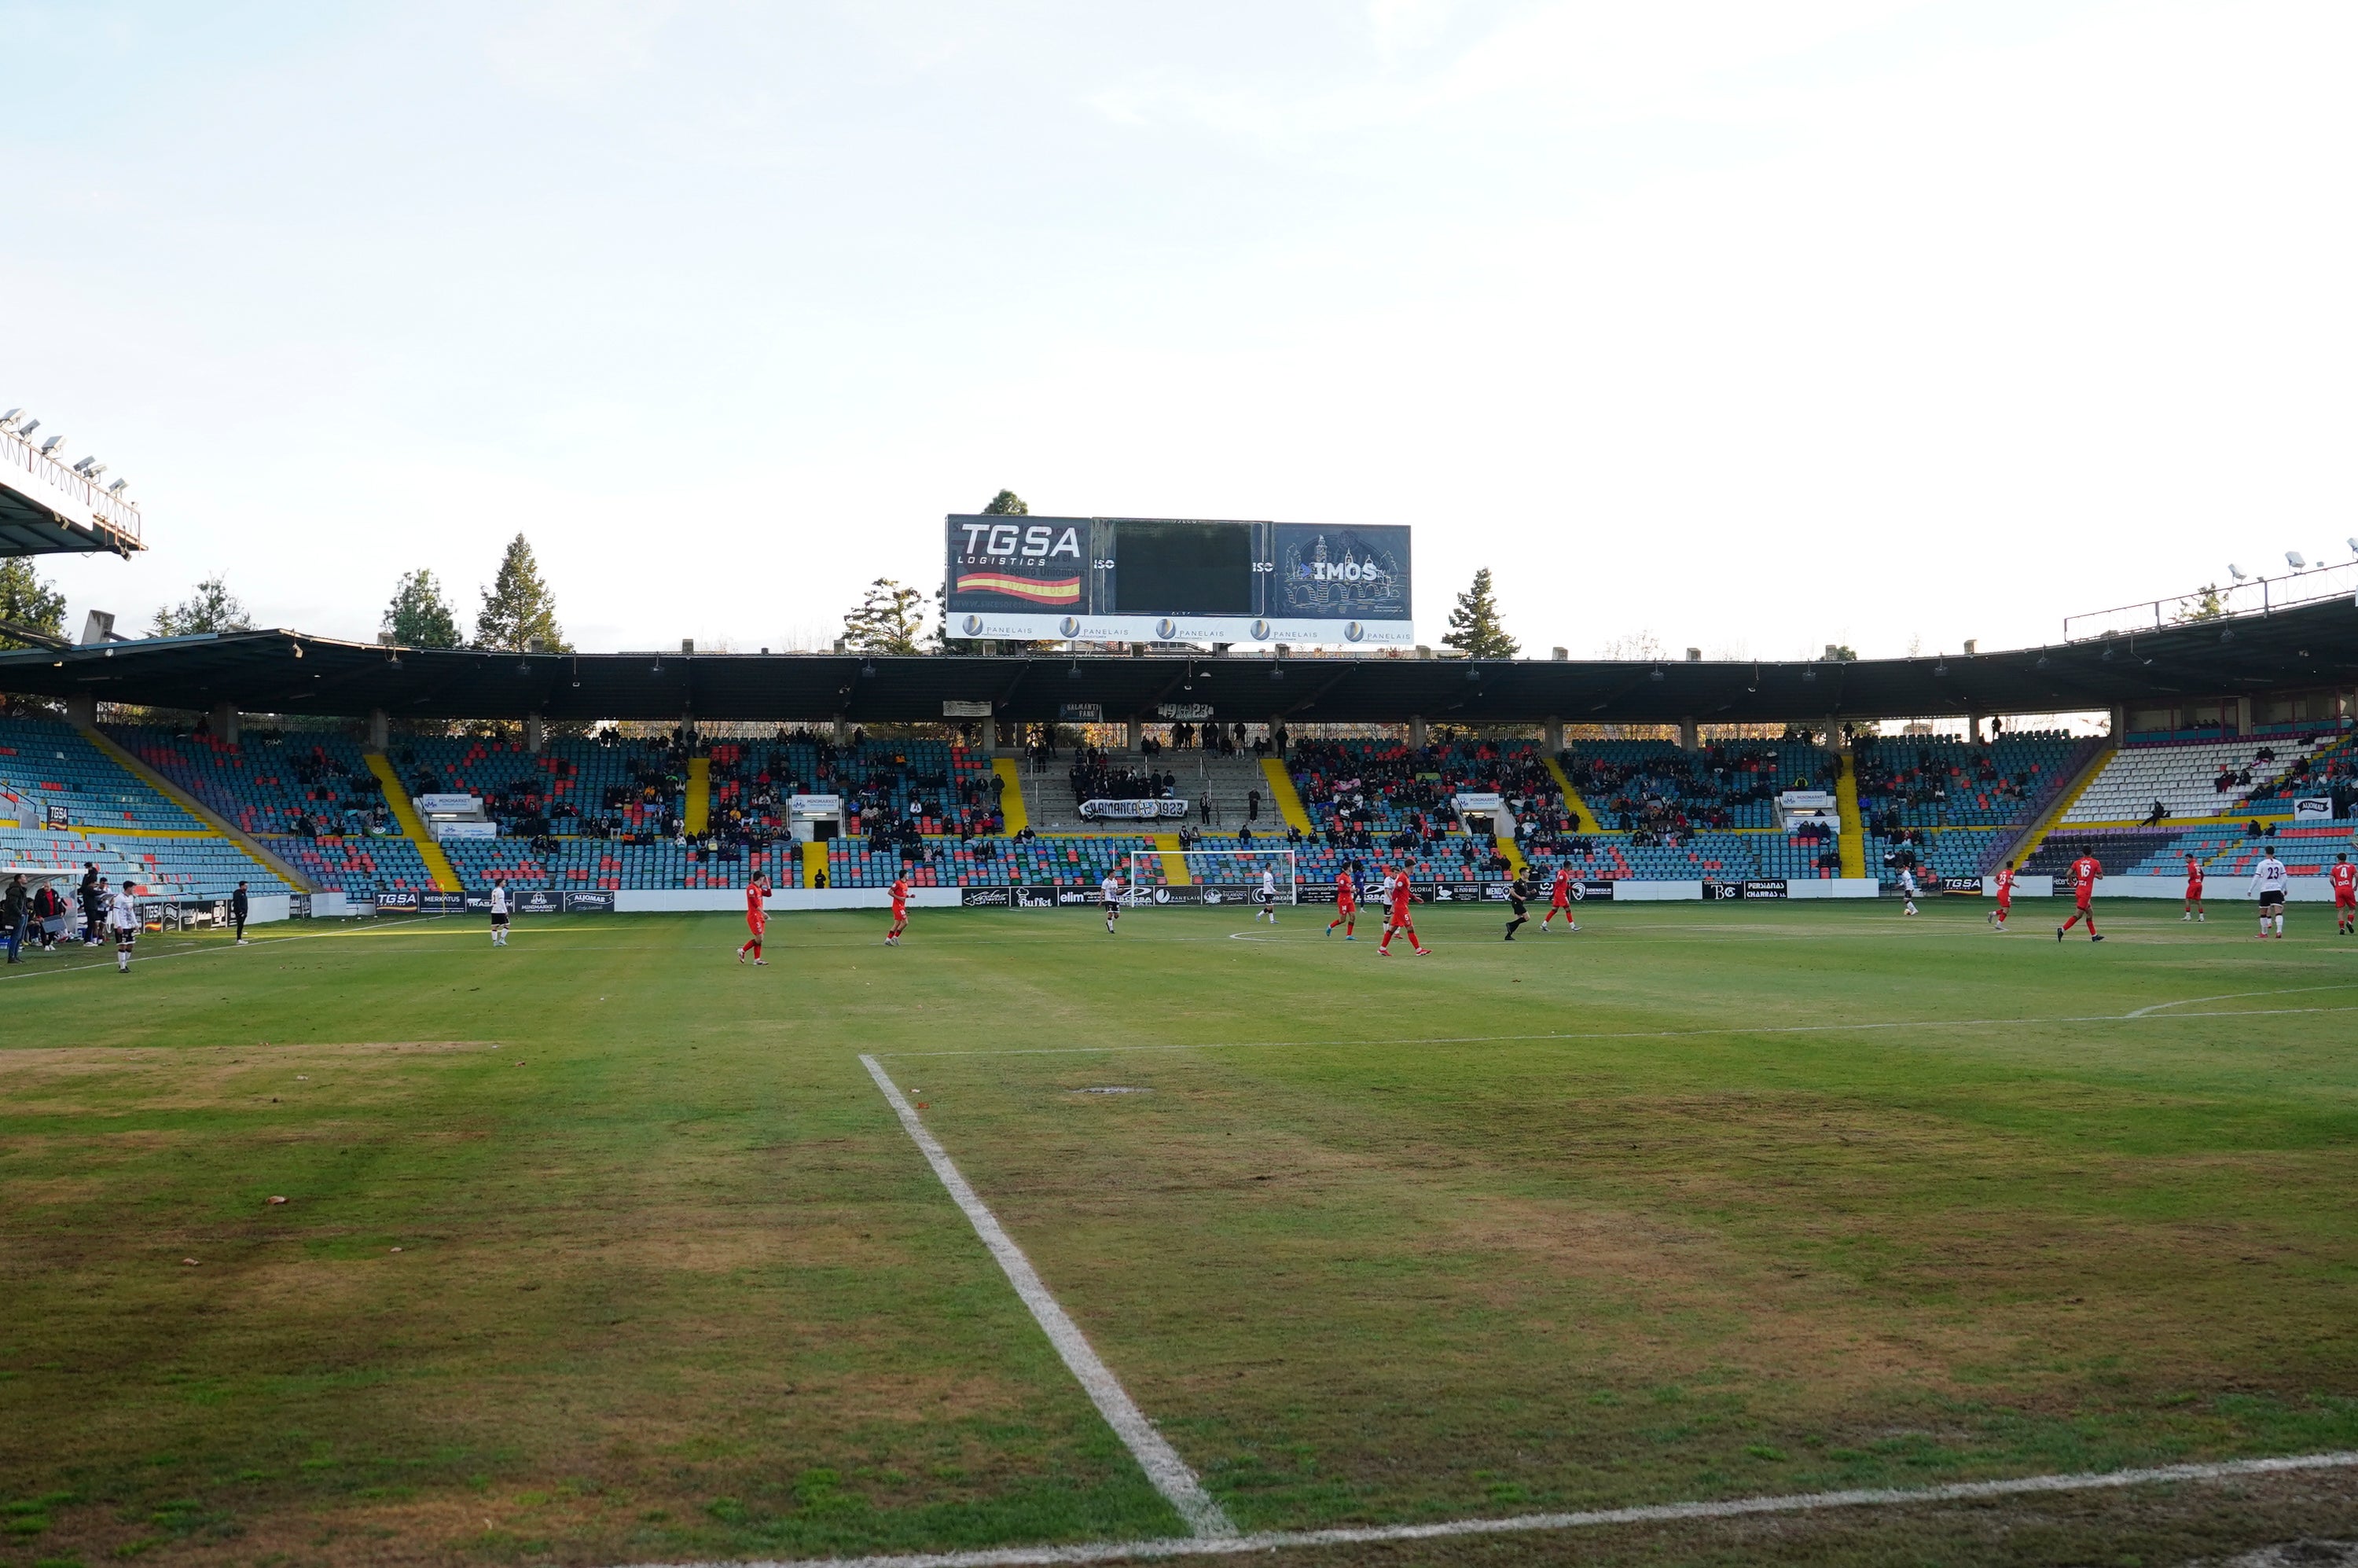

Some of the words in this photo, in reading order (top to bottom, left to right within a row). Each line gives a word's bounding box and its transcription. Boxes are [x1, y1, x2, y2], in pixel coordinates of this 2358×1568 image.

[961, 523, 1081, 558] TGSA
[957, 556, 1046, 566] LOGISTICS
[1093, 559, 1115, 570] ISO
[1252, 562, 1274, 573] ISO
[1313, 561, 1378, 582] IMOS
[986, 626, 1033, 636] PANELAIS
[1083, 628, 1129, 637] PANELAIS
[1180, 630, 1225, 638] PANELAIS
[1273, 631, 1318, 640] PANELAIS
[1367, 633, 1411, 641] PANELAIS
[1158, 802, 1184, 815] 1923
[2302, 802, 2324, 810] ALJOMAR
[50, 806, 68, 821] TGSA
[2080, 864, 2092, 878] 16
[2267, 866, 2279, 879] 23
[2340, 867, 2349, 879] 4
[1944, 879, 1982, 888] TGSA
[1999, 873, 2007, 885] 23
[377, 894, 417, 903] TGSA
[574, 894, 606, 903] ALJOMAR
[1019, 897, 1052, 907] Buffet
[145, 905, 163, 919] TGSA
